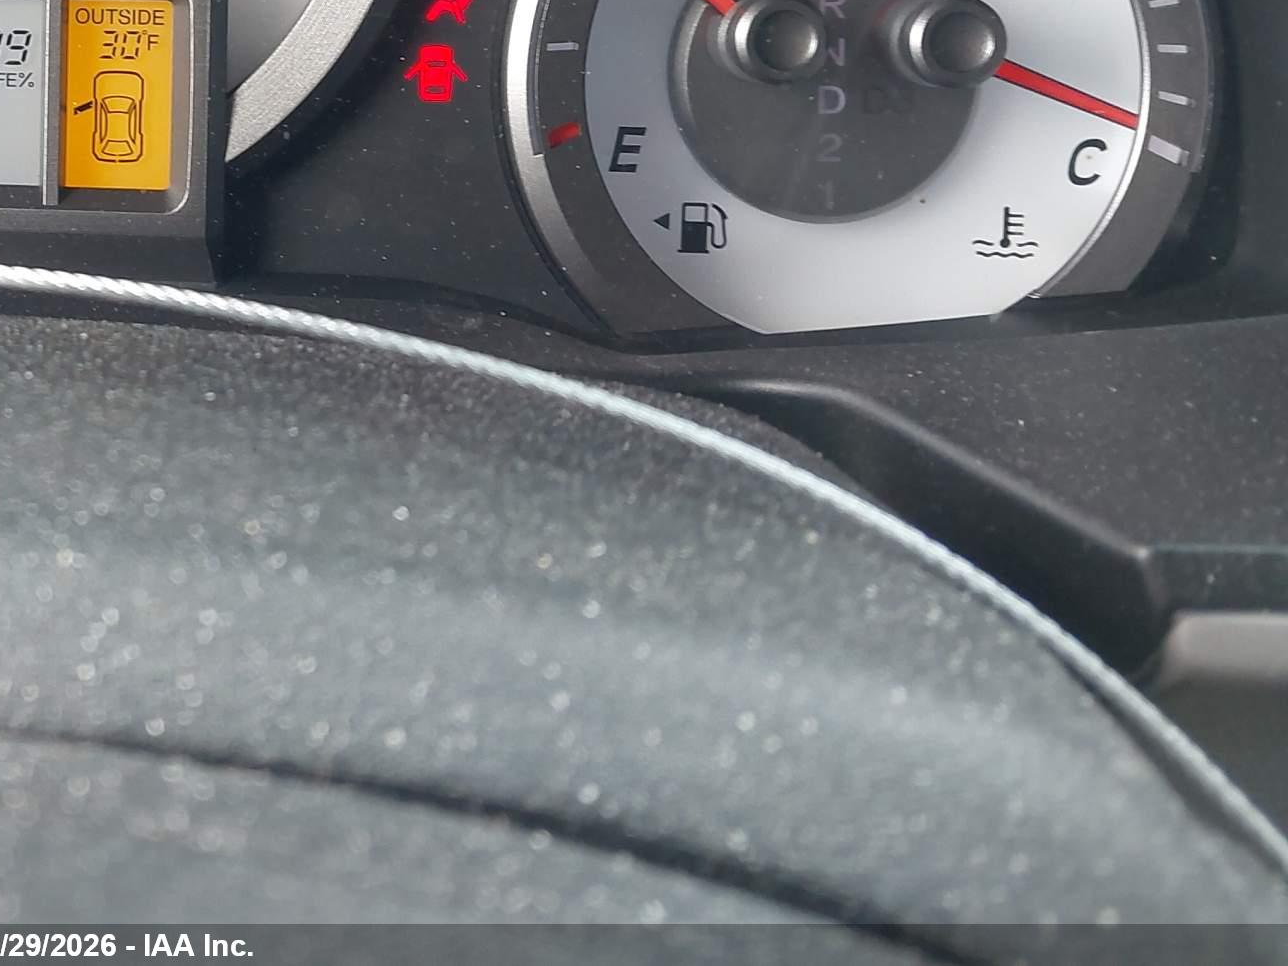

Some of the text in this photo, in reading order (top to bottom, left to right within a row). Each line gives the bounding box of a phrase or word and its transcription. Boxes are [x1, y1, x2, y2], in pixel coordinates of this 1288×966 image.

[75, 7, 166, 26] OUTSIDE
[816, 85, 847, 115] D
[608, 125, 648, 173] E
[816, 133, 843, 163] 2
[1067, 138, 1108, 186] C
